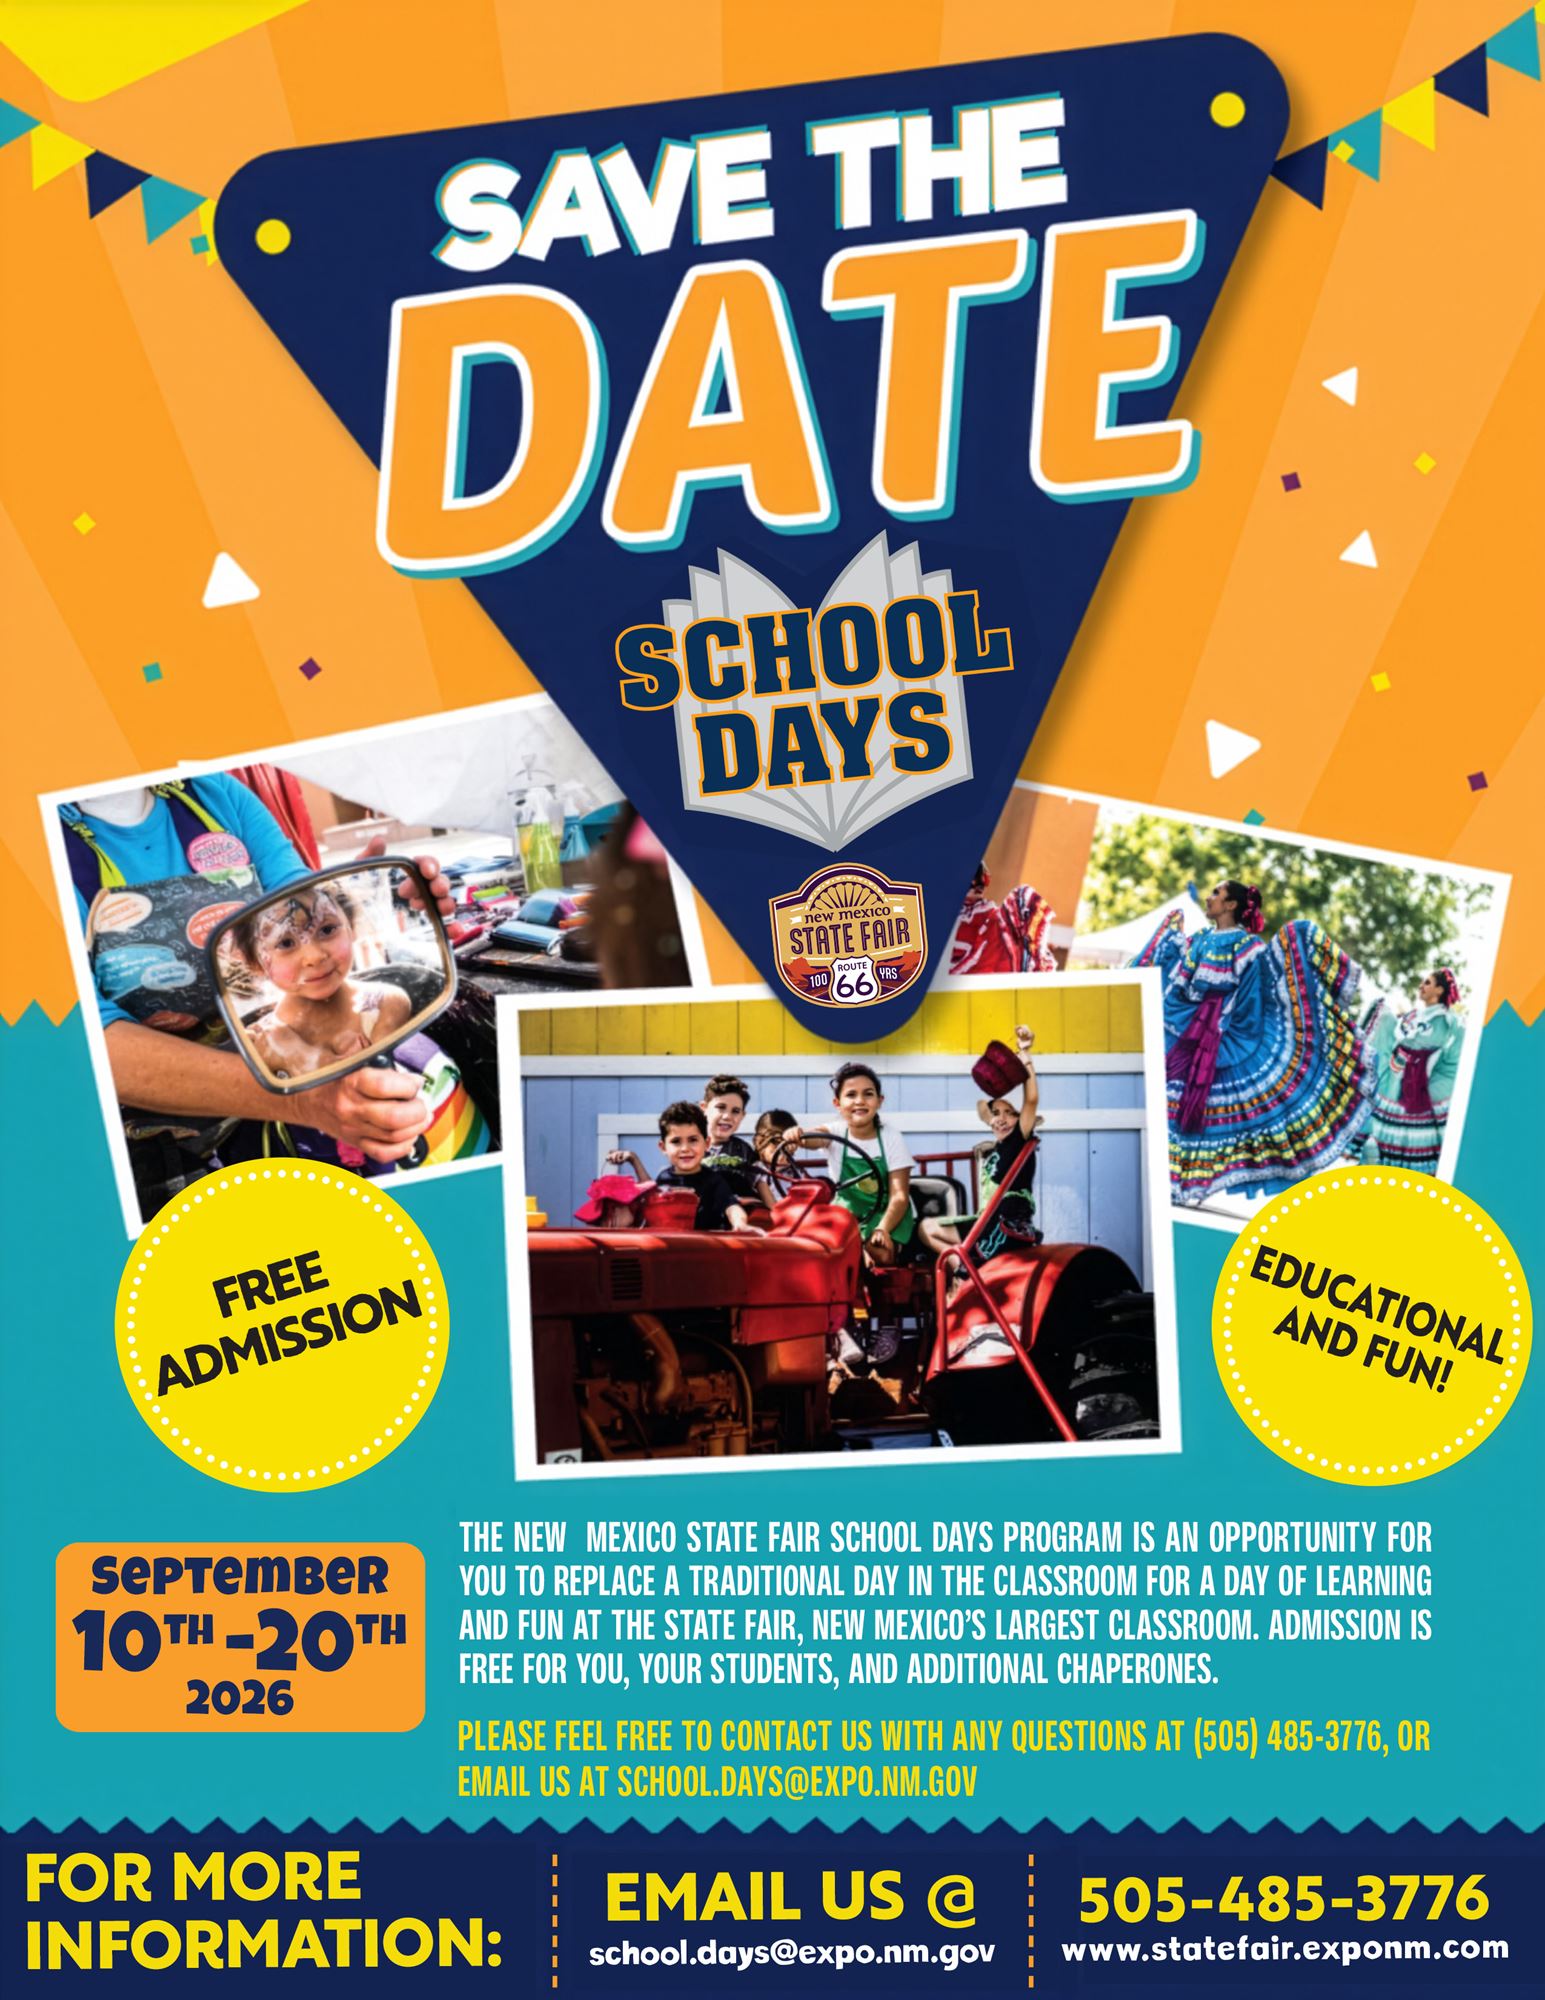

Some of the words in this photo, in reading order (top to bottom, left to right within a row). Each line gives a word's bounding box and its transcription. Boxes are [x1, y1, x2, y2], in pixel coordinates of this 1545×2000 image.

[433, 125, 776, 273] SAVE
[805, 91, 1067, 230] THE
[376, 207, 1208, 580] DATE
[615, 589, 1015, 712] SCHOOL
[691, 690, 954, 797] DAYS
[804, 910, 834, 924] new
[838, 905, 891, 920] mexico
[789, 922, 855, 955] STATE
[860, 917, 910, 951] FAIR
[809, 972, 828, 988] 100
[879, 967, 898, 980] YRS
[836, 973, 874, 997] 66
[837, 962, 868, 971] ROUTE
[212, 1250, 330, 1318] FREE
[1250, 1244, 1504, 1365] EDUCATIONAL
[157, 1279, 422, 1397] ADMISSION
[1272, 1305, 1358, 1358] AND
[1363, 1333, 1454, 1393] FUN!
[460, 1522, 503, 1552] THE
[515, 1522, 566, 1552] NEW
[587, 1521, 676, 1552] MEXICO
[687, 1522, 757, 1552] STATE
[769, 1522, 819, 1552] FAIR
[831, 1521, 921, 1552] SCHOOL
[933, 1522, 993, 1552] DAYS
[1004, 1521, 1121, 1552] PROGRAM
[1134, 1522, 1154, 1552] IS
[1165, 1522, 1198, 1552] AN
[1210, 1521, 1376, 1552] OPPORTUNITY
[1388, 1522, 1431, 1552] FOR
[460, 1565, 505, 1596] YOU
[515, 1565, 544, 1596] TO
[555, 1565, 655, 1596] REPLACE
[664, 1565, 679, 1595] A
[689, 1565, 844, 1596] TRADITIONAL
[855, 1565, 899, 1595] DAY
[909, 1565, 932, 1595] IN
[941, 1566, 984, 1595] THE
[994, 1565, 1136, 1596] CLASSROOM
[1147, 1565, 1189, 1596] FOR
[1200, 1566, 1215, 1595] A
[1225, 1565, 1269, 1595] DAY
[1279, 1565, 1306, 1596] OF
[1317, 1565, 1431, 1596] LEARNING
[460, 1610, 508, 1640] AND
[519, 1610, 563, 1640] FUN
[573, 1610, 601, 1639] AT
[612, 1610, 655, 1640] THE
[665, 1609, 735, 1640] STATE
[746, 1610, 803, 1646] FAIR,
[813, 1610, 865, 1640] NEW
[875, 1609, 985, 1640] MEXICO’S
[996, 1609, 1099, 1640] LARGEST
[1109, 1609, 1259, 1640] CLASSROOM.
[1269, 1609, 1400, 1640] ADMISSION
[1411, 1609, 1431, 1640] IS
[460, 1653, 513, 1683] FREE
[524, 1653, 566, 1684] FOR
[577, 1653, 629, 1689] YOU,
[639, 1653, 701, 1683] YOUR
[711, 1653, 839, 1689] STUDENTS,
[849, 1653, 897, 1683] AND
[907, 1653, 1048, 1683] ADDITIONAL
[1058, 1653, 1218, 1683] CHAPERONES.
[186, 1679, 294, 1715] 2026
[459, 1720, 546, 1751] PLEASE
[556, 1720, 607, 1750] FEEL
[617, 1721, 672, 1750] FREE
[682, 1720, 711, 1751] TO
[722, 1720, 832, 1751] CONTACT
[842, 1720, 872, 1751] US
[881, 1721, 942, 1750] WITH
[953, 1721, 1002, 1750] ANY
[1012, 1720, 1146, 1753] QUESTIONS
[1156, 1720, 1184, 1750] AT
[1195, 1717, 1257, 1759] (505)
[1268, 1720, 1388, 1757] 485-3776,
[1398, 1720, 1429, 1751] OR
[459, 1766, 530, 1796] EMAIL
[541, 1766, 570, 1796] US
[580, 1766, 609, 1796] AT
[618, 1766, 977, 1800] SCHOOL.DAYS@EXPO.NM.GOV
[27, 1853, 152, 1902] FOR
[174, 1851, 362, 1901] MORE
[608, 1872, 800, 1921] EMAIL
[823, 1870, 905, 1921] US
[928, 1875, 976, 1929] @
[1081, 1875, 1490, 1923] 505-485-3776
[27, 1918, 502, 1969] INFORMATION:
[589, 1939, 996, 1972] school.days@expo.nm.gov
[1061, 1935, 1509, 1967] www.statefair.exponm.com
